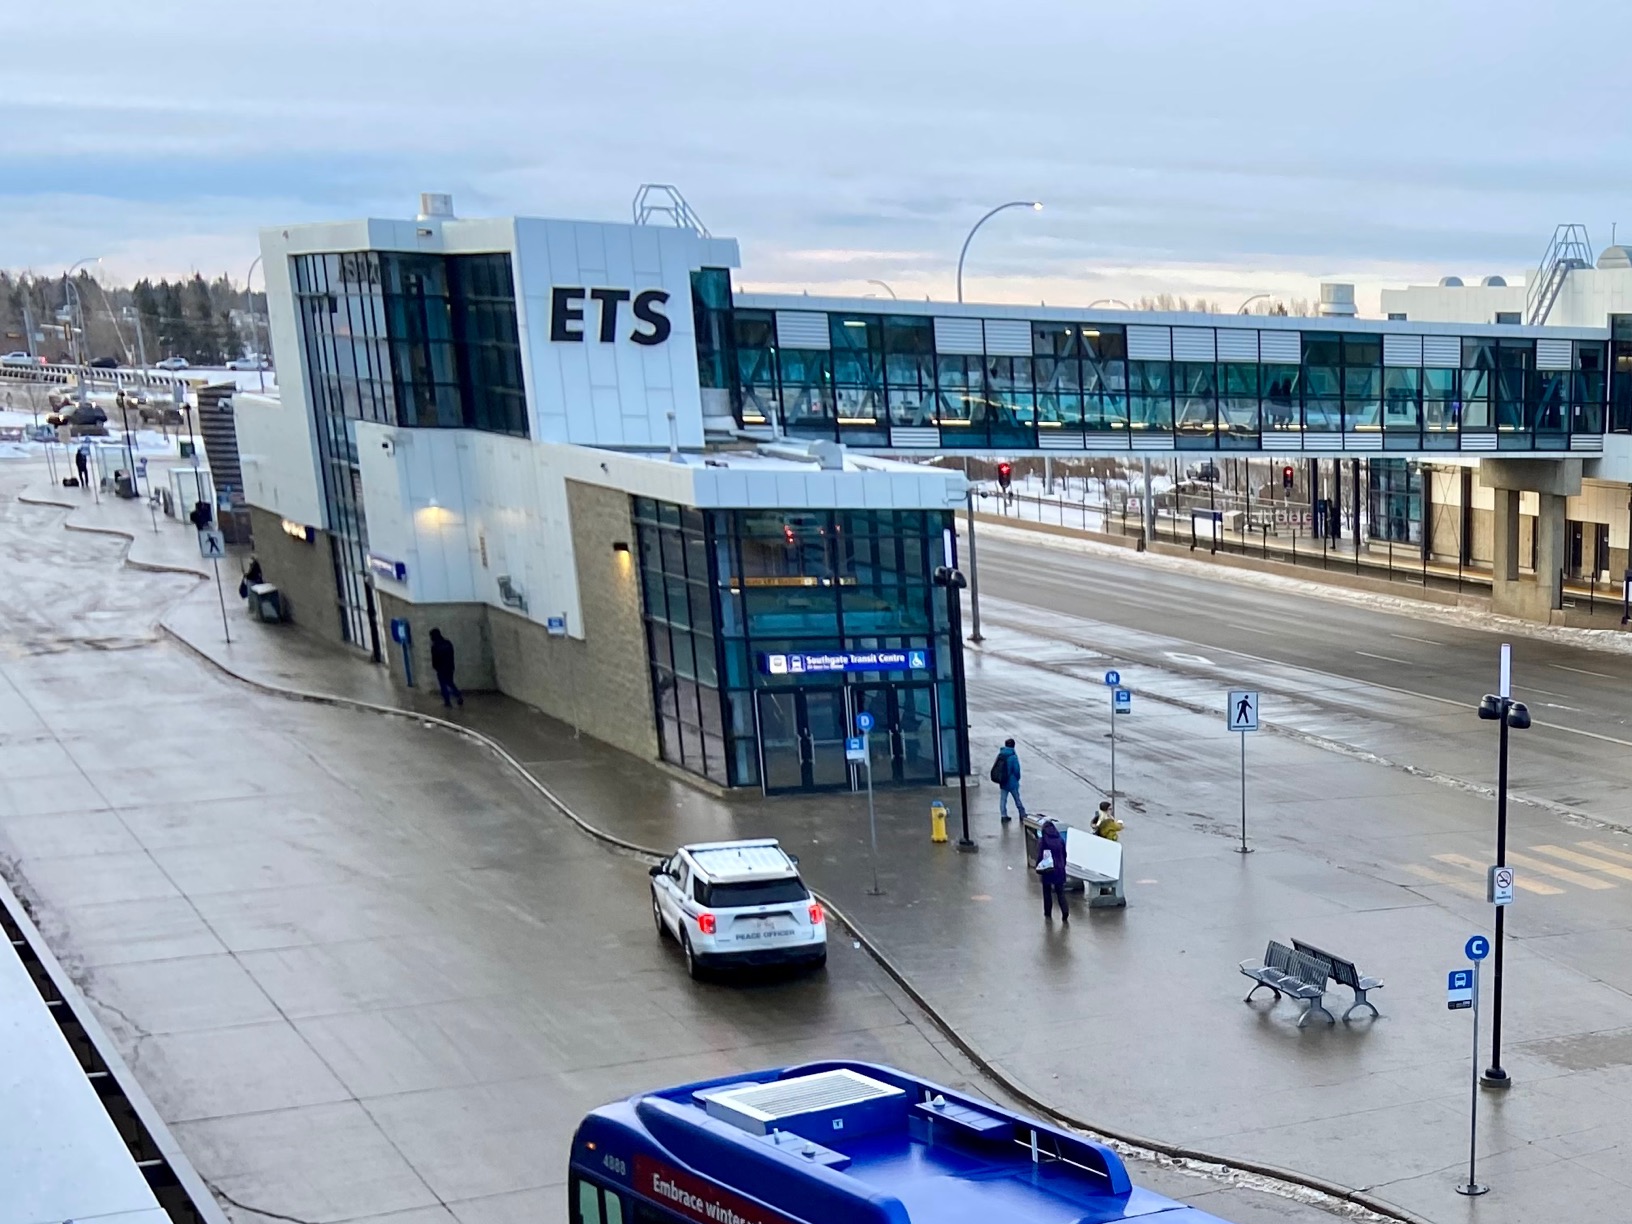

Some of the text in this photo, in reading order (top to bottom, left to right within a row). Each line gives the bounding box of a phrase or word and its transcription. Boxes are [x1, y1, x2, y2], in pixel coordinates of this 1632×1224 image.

[551, 287, 671, 345] ETS
[806, 654, 905, 665] Southgate Transit Centre
[1108, 673, 1116, 683] N
[861, 716, 870, 726] D
[1472, 940, 1482, 954] C
[652, 1172, 704, 1213] Embrace
